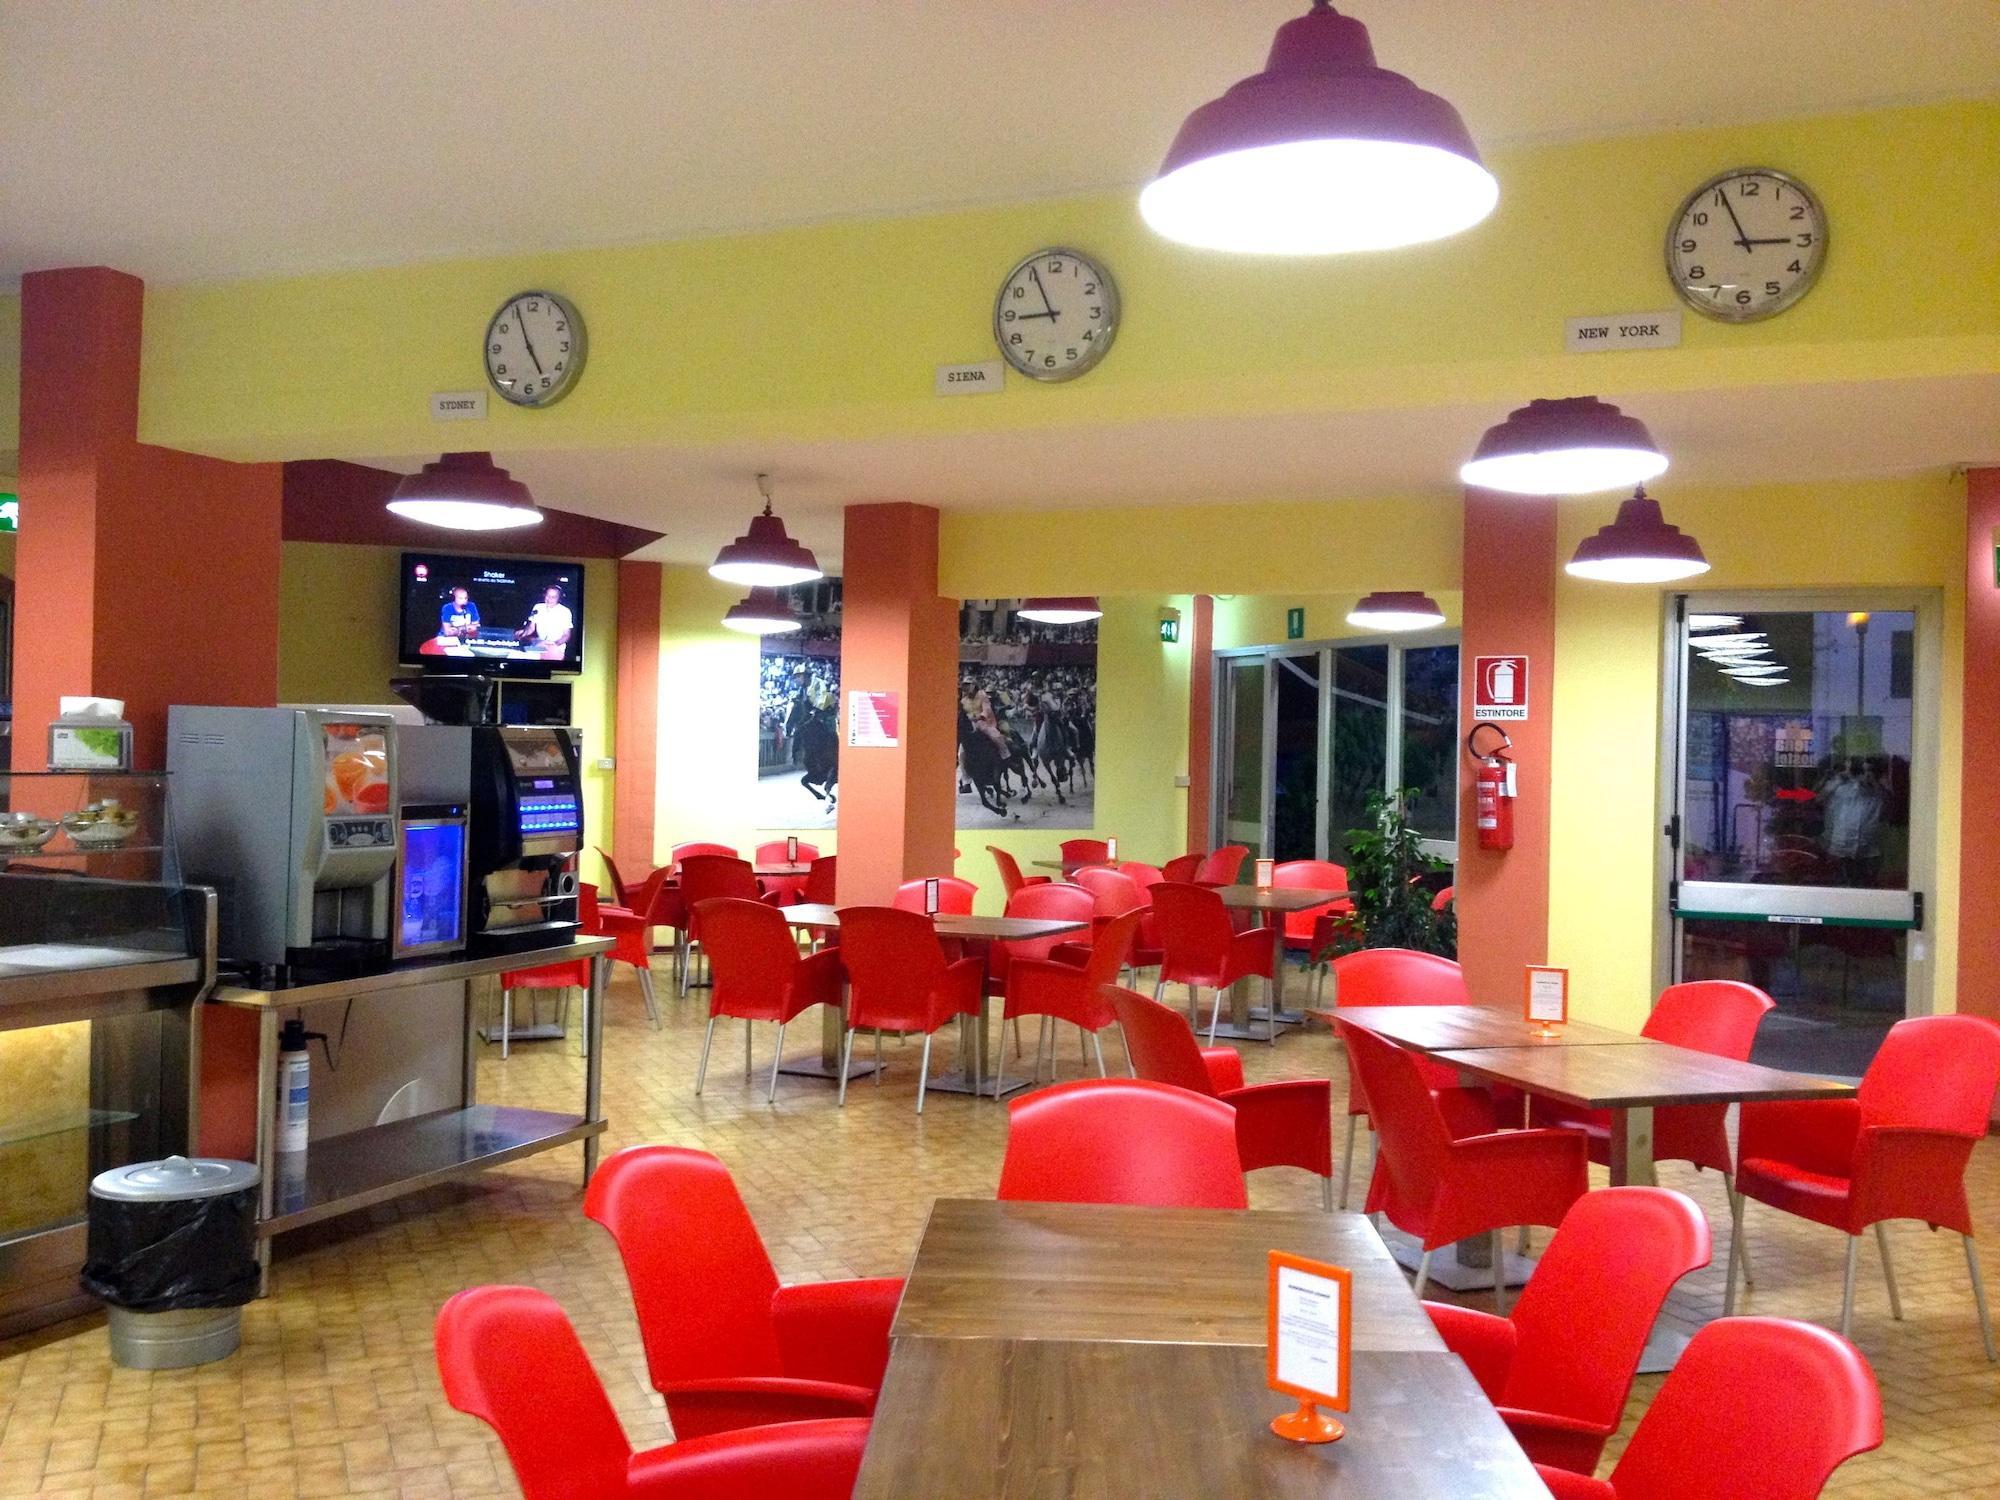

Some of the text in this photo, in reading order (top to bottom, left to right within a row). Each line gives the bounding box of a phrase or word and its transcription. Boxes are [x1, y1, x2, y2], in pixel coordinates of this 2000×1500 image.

[1741, 183, 1759, 196] 12
[1790, 206, 1805, 220] 2
[1693, 213, 1708, 226] 10
[1681, 240, 1696, 253] 9
[1797, 233, 1812, 248] 3
[1048, 261, 1062, 273] 12
[1689, 266, 1705, 279] 8
[1787, 259, 1802, 274] 4
[1013, 287, 1024, 299] 10
[1085, 283, 1095, 295] 2
[1709, 284, 1721, 298] 7
[1766, 281, 1780, 295] 5
[1736, 290, 1751, 304] 6
[527, 302, 539, 312] 12
[1090, 307, 1101, 319] 3
[1004, 310, 1016, 322] 9
[556, 321, 565, 331] 2
[1578, 325, 1660, 339] NEW YORK
[1010, 333, 1022, 345] 8
[1082, 330, 1093, 341] 4
[492, 344, 502, 354] 9
[560, 342, 569, 353] 3
[1025, 350, 1034, 362] 7
[1066, 348, 1078, 360] 5
[555, 361, 562, 371] 4
[1044, 355, 1056, 368] 6
[497, 364, 507, 374] 8
[541, 377, 551, 388] 5
[947, 371, 986, 382] SIENA
[509, 379, 517, 389] 7
[524, 384, 534, 394] 6
[439, 401, 476, 410] SYDNEY
[1475, 709, 1525, 717] ESTINTORE
